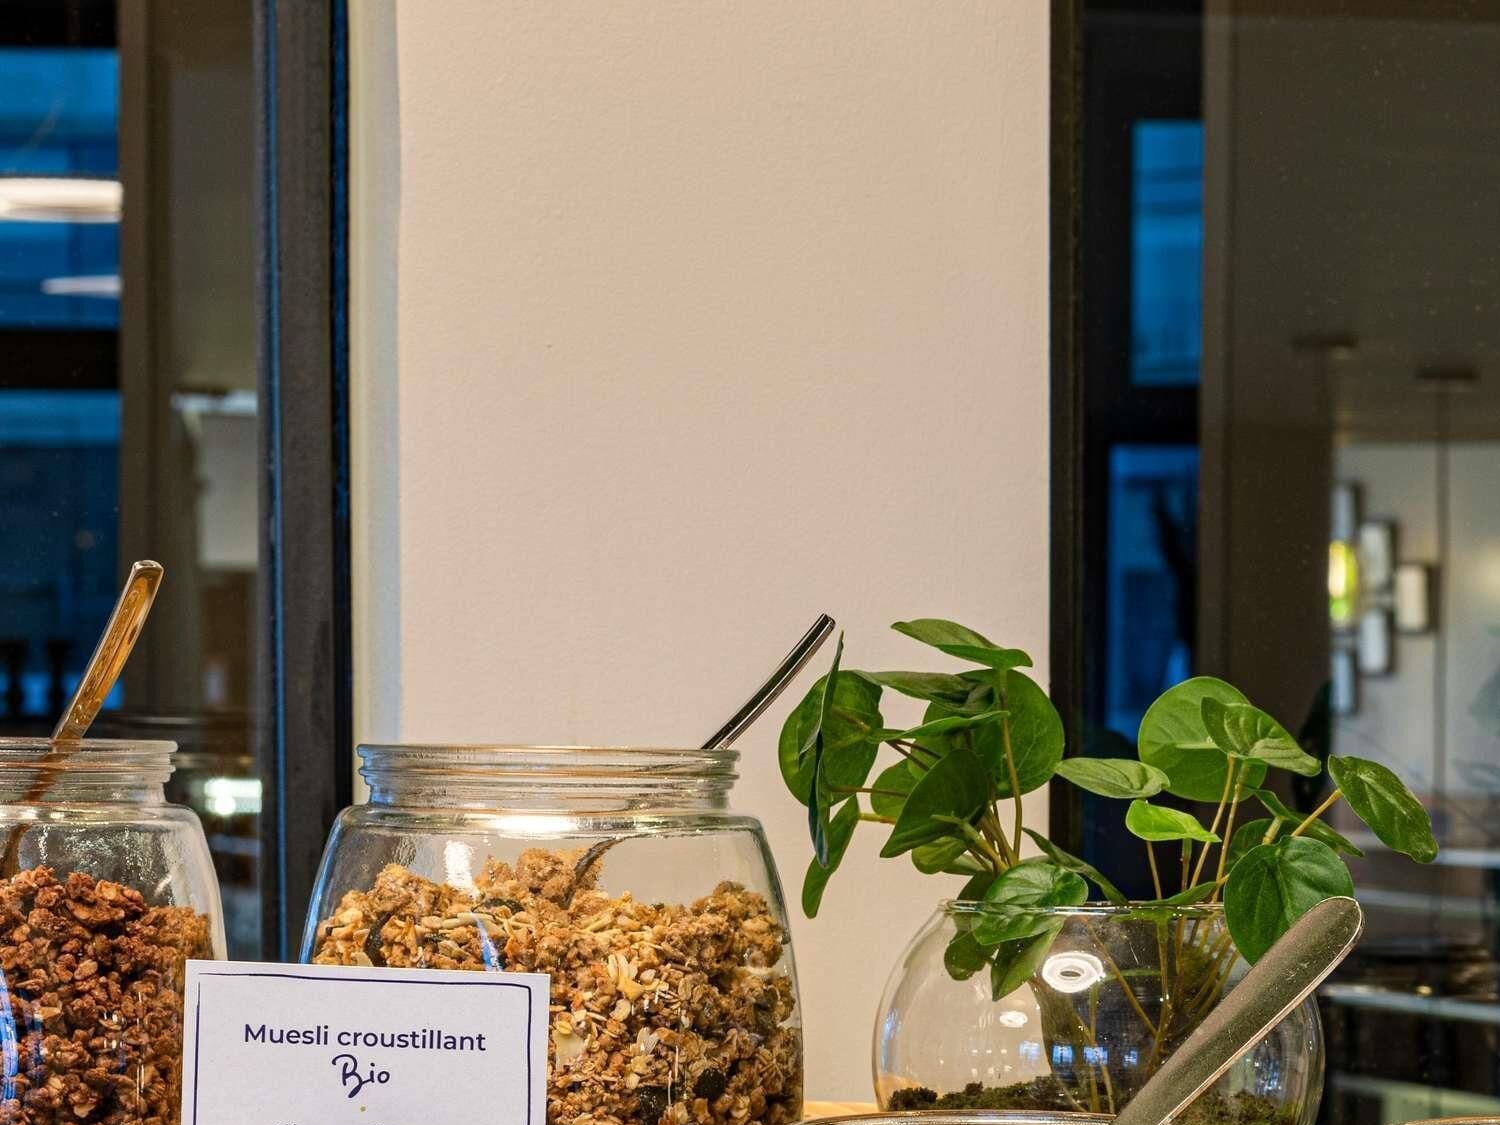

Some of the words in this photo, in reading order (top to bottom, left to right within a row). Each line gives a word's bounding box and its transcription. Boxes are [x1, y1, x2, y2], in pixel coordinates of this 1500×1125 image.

[244, 1023, 330, 1047] Muesli
[336, 1027, 487, 1051] croustillant
[331, 1053, 391, 1099] Bio
